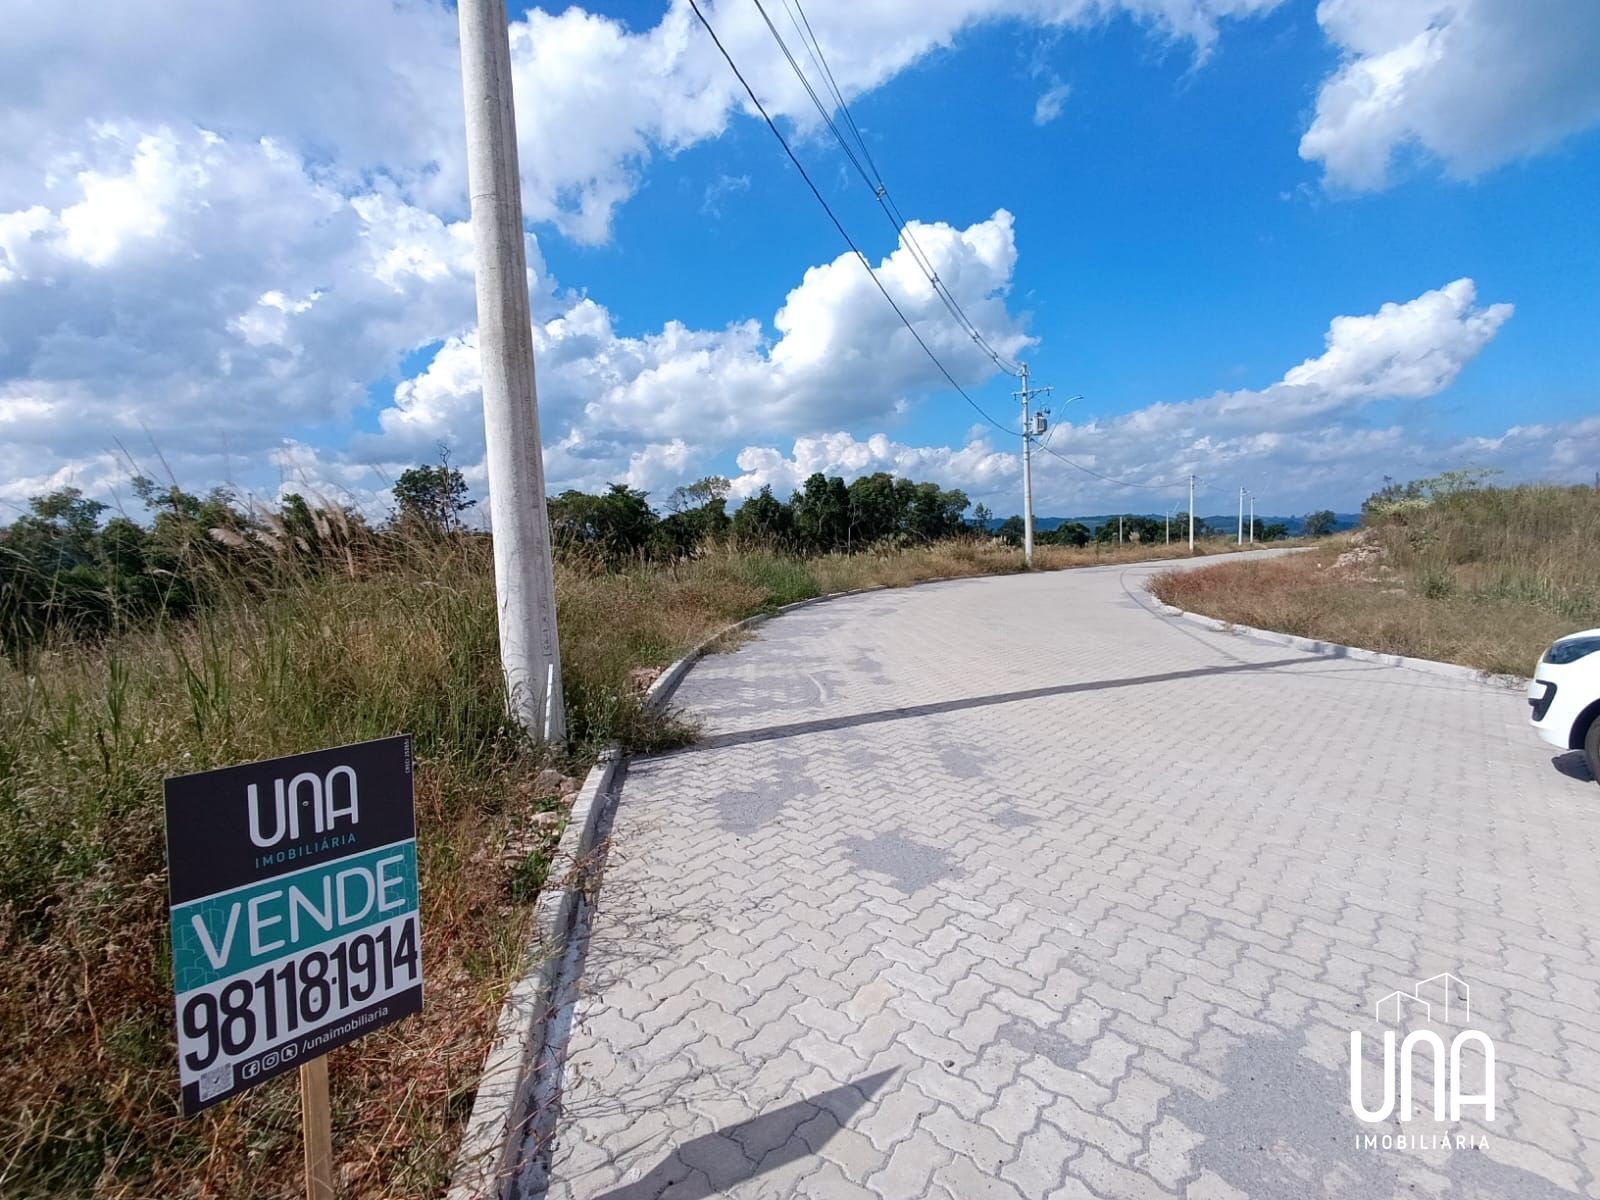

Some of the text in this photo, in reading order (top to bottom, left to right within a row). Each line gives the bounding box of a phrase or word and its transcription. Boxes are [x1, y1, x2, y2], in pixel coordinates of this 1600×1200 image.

[247, 765, 359, 847] UNA
[255, 832, 356, 868] IMOBILIÁRIA
[192, 854, 406, 970] VENDE
